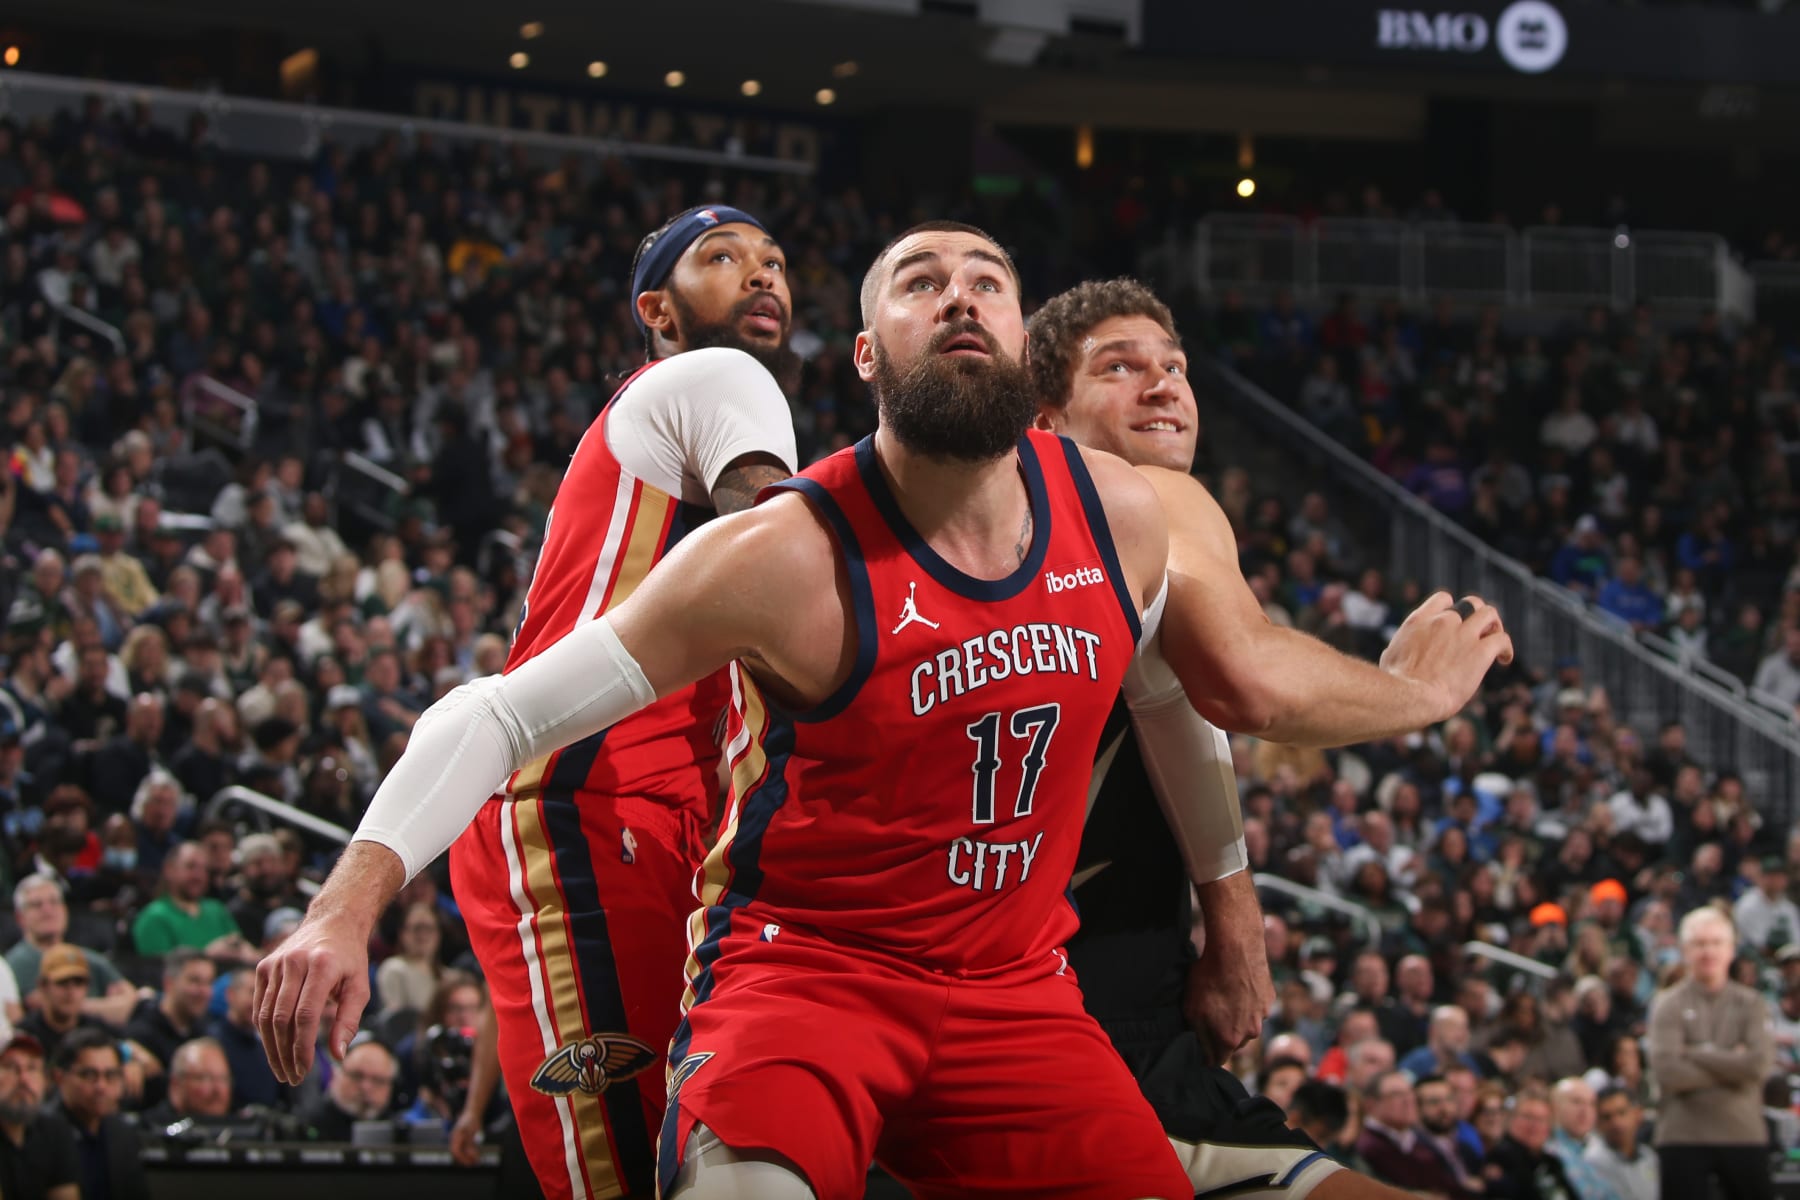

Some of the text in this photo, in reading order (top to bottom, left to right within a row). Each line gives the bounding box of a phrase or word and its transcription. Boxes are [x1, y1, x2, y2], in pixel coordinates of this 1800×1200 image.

[1376, 9, 1489, 52] BMO
[1045, 567, 1104, 594] ibotta
[910, 622, 1101, 717] CRESCENT
[966, 702, 1061, 825] 17
[947, 831, 1044, 891] CITY
